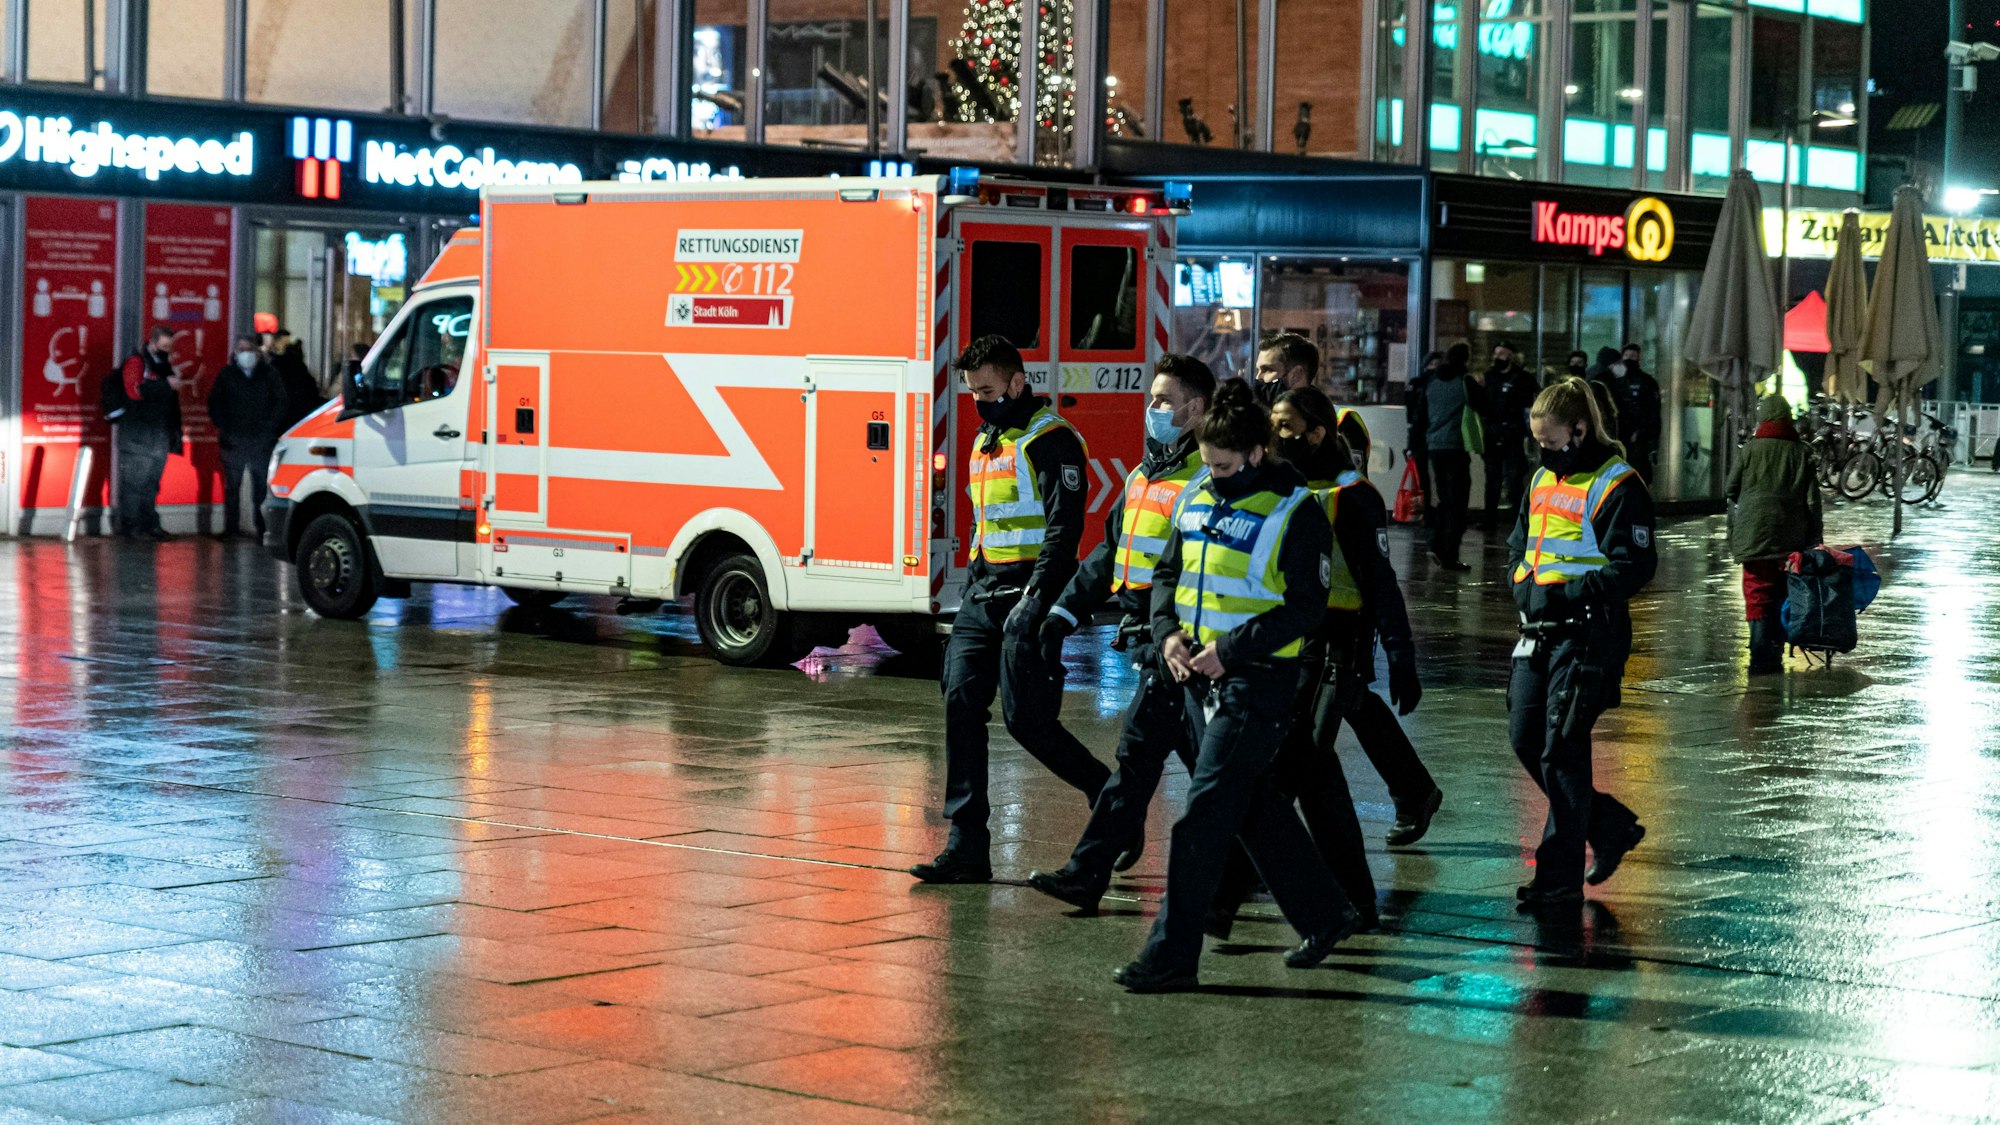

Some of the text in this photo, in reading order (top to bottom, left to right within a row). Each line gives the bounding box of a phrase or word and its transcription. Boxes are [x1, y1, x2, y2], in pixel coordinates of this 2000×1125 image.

[25, 115, 253, 181] Highspeed
[1537, 201, 1625, 256] Kamps
[679, 238, 799, 254] RETTUNGSDIENST
[752, 263, 794, 295] 112
[693, 305, 738, 318] Stadt Köln
[1114, 367, 1142, 390] 112
[519, 397, 530, 406] G1
[871, 411, 885, 421] G5
[552, 547, 564, 558] G3
